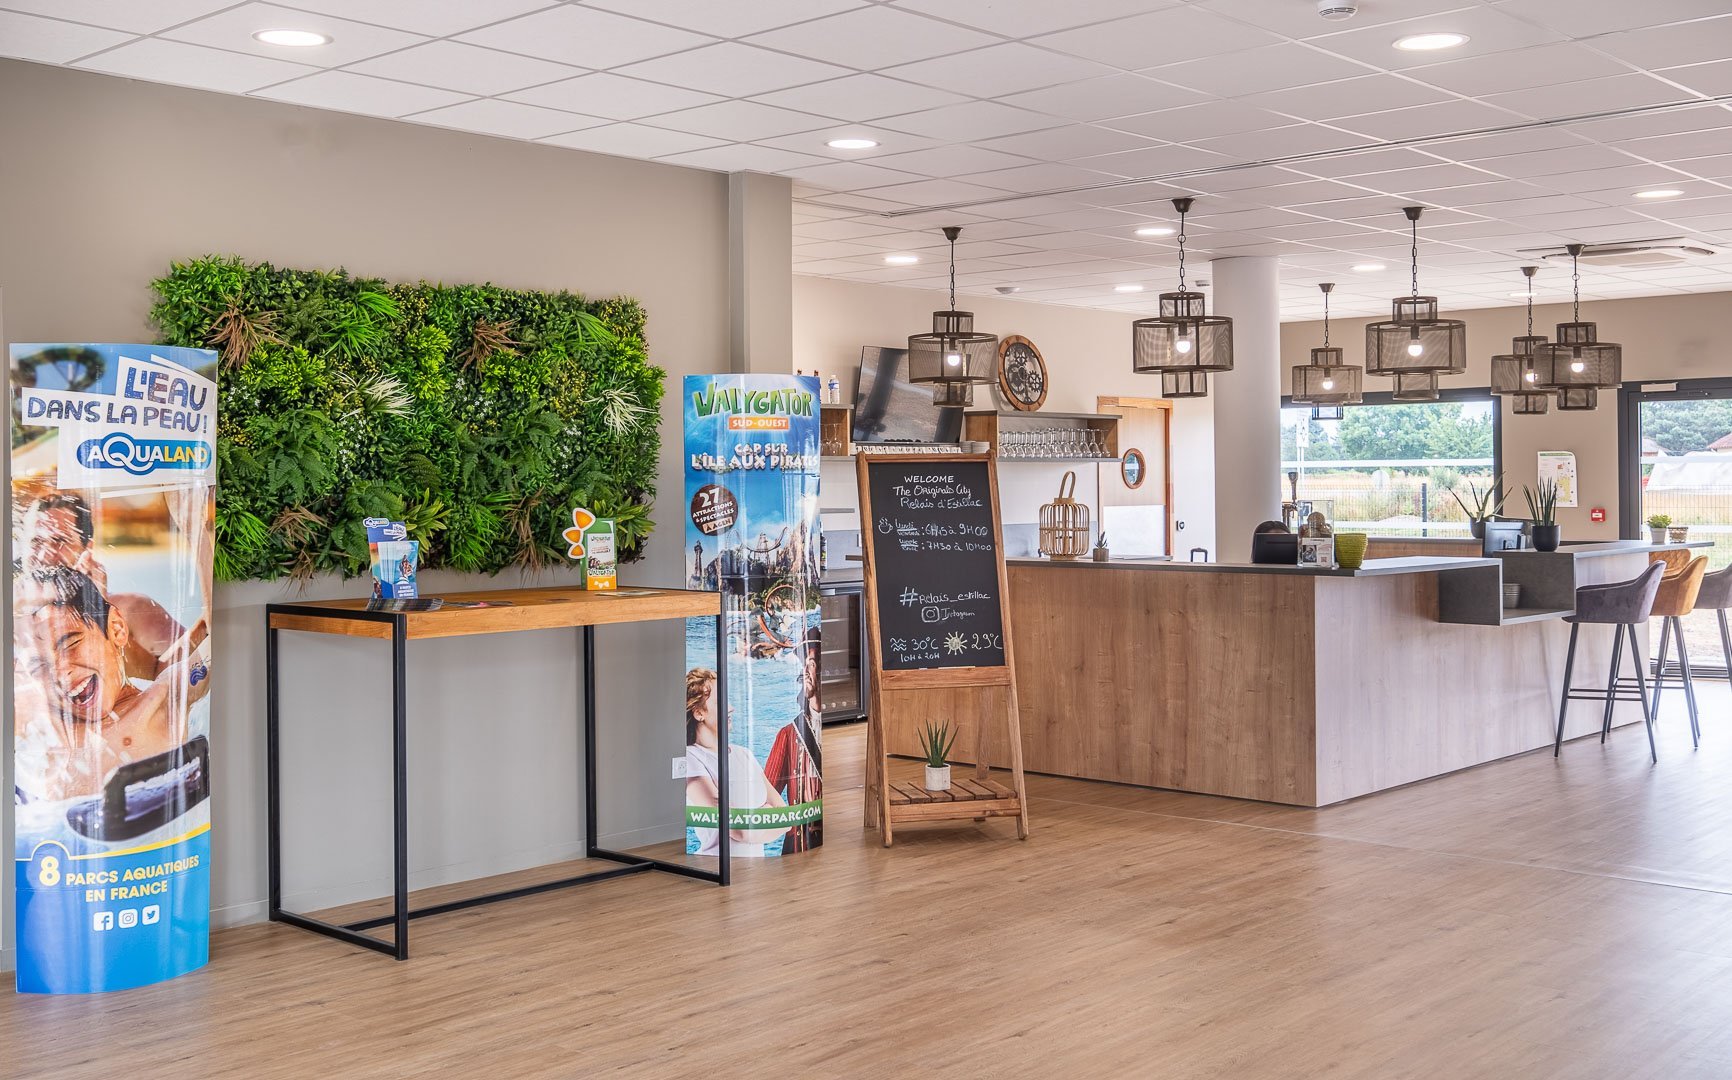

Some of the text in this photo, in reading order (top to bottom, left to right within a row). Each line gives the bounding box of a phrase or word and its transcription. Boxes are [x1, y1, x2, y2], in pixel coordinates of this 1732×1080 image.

[124, 367, 208, 411] L'EAU
[693, 383, 812, 417] WALYGATOR
[28, 397, 100, 423] DANS
[106, 403, 138, 425] LA
[87, 436, 208, 472] AQUALAND
[735, 443, 789, 456] CAP SUR
[691, 452, 727, 470] L'ÎLE
[729, 455, 766, 470] AUX
[904, 475, 955, 483] WELCOME
[700, 487, 720, 508] 27
[893, 486, 911, 496] The
[914, 485, 955, 498] Originals
[693, 501, 733, 518] ATTRACTIONS
[900, 497, 934, 509] Relais
[959, 522, 988, 537] 9H00
[39, 855, 200, 886] 8 PARCS AQUATIQUES
[86, 880, 168, 903] EN FRANCE
